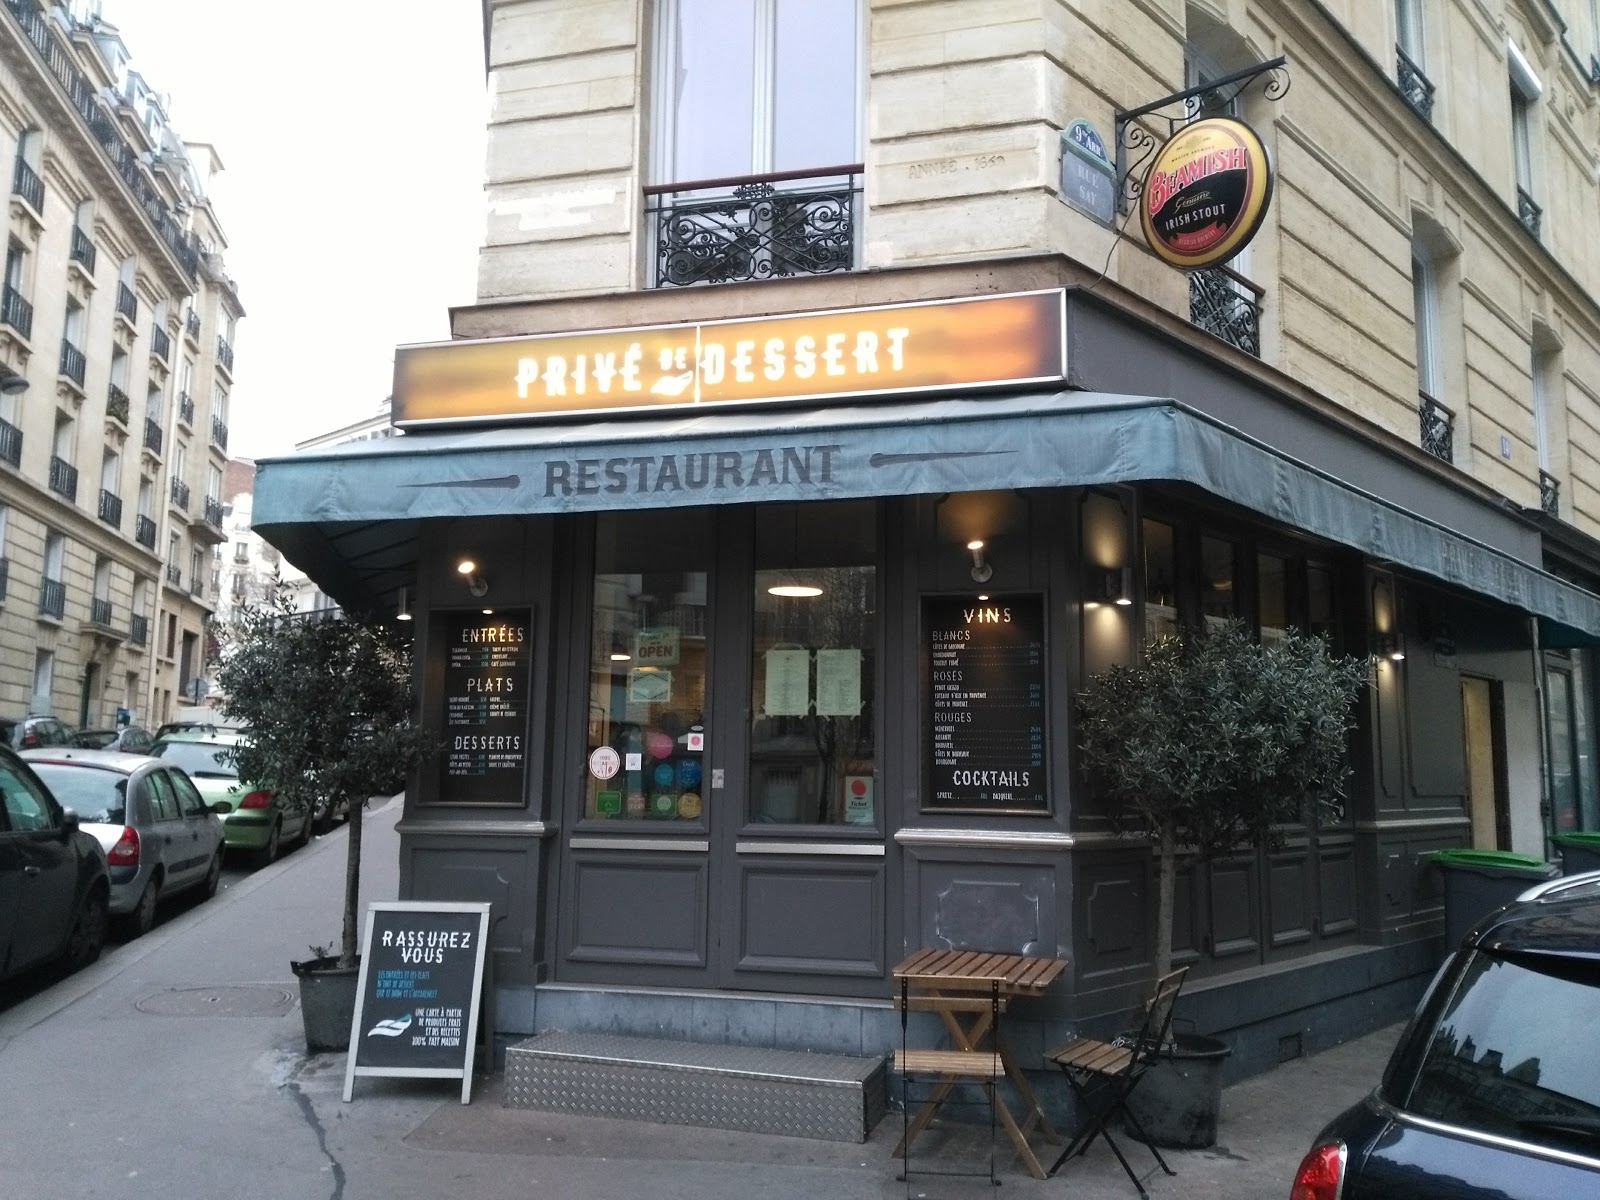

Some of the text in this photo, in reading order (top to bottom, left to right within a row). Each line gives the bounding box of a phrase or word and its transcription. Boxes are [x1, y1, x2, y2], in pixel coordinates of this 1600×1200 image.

[1078, 164, 1099, 188] RUE
[1150, 147, 1247, 215] BEAMISH
[1079, 184, 1097, 205] SAY
[1173, 190, 1212, 214] Genuine
[1165, 203, 1226, 231] IRISH STOUT
[514, 342, 643, 399] PRIVÉ
[700, 327, 909, 386] DESSERT
[543, 445, 842, 498] RESTAURANT
[963, 607, 1011, 624] VINS
[462, 624, 524, 643] ENTRÉES
[932, 630, 971, 641] BLANCS
[638, 645, 673, 658] OPEN
[466, 677, 514, 692] PLATS
[934, 712, 972, 723] ROUGES
[454, 735, 521, 750] DESSERTS
[953, 770, 1030, 787] COCKTAILS
[382, 930, 471, 949] RASSUREZ
[401, 947, 444, 964] VOUS
[415, 1006, 462, 1018] UNE CARTE À PARTIR
[418, 1018, 461, 1027] DE PRODUITS FRAIS
[425, 1027, 461, 1037] ET DES RECETTES
[411, 1036, 460, 1047] 100% FAIT MAISON
